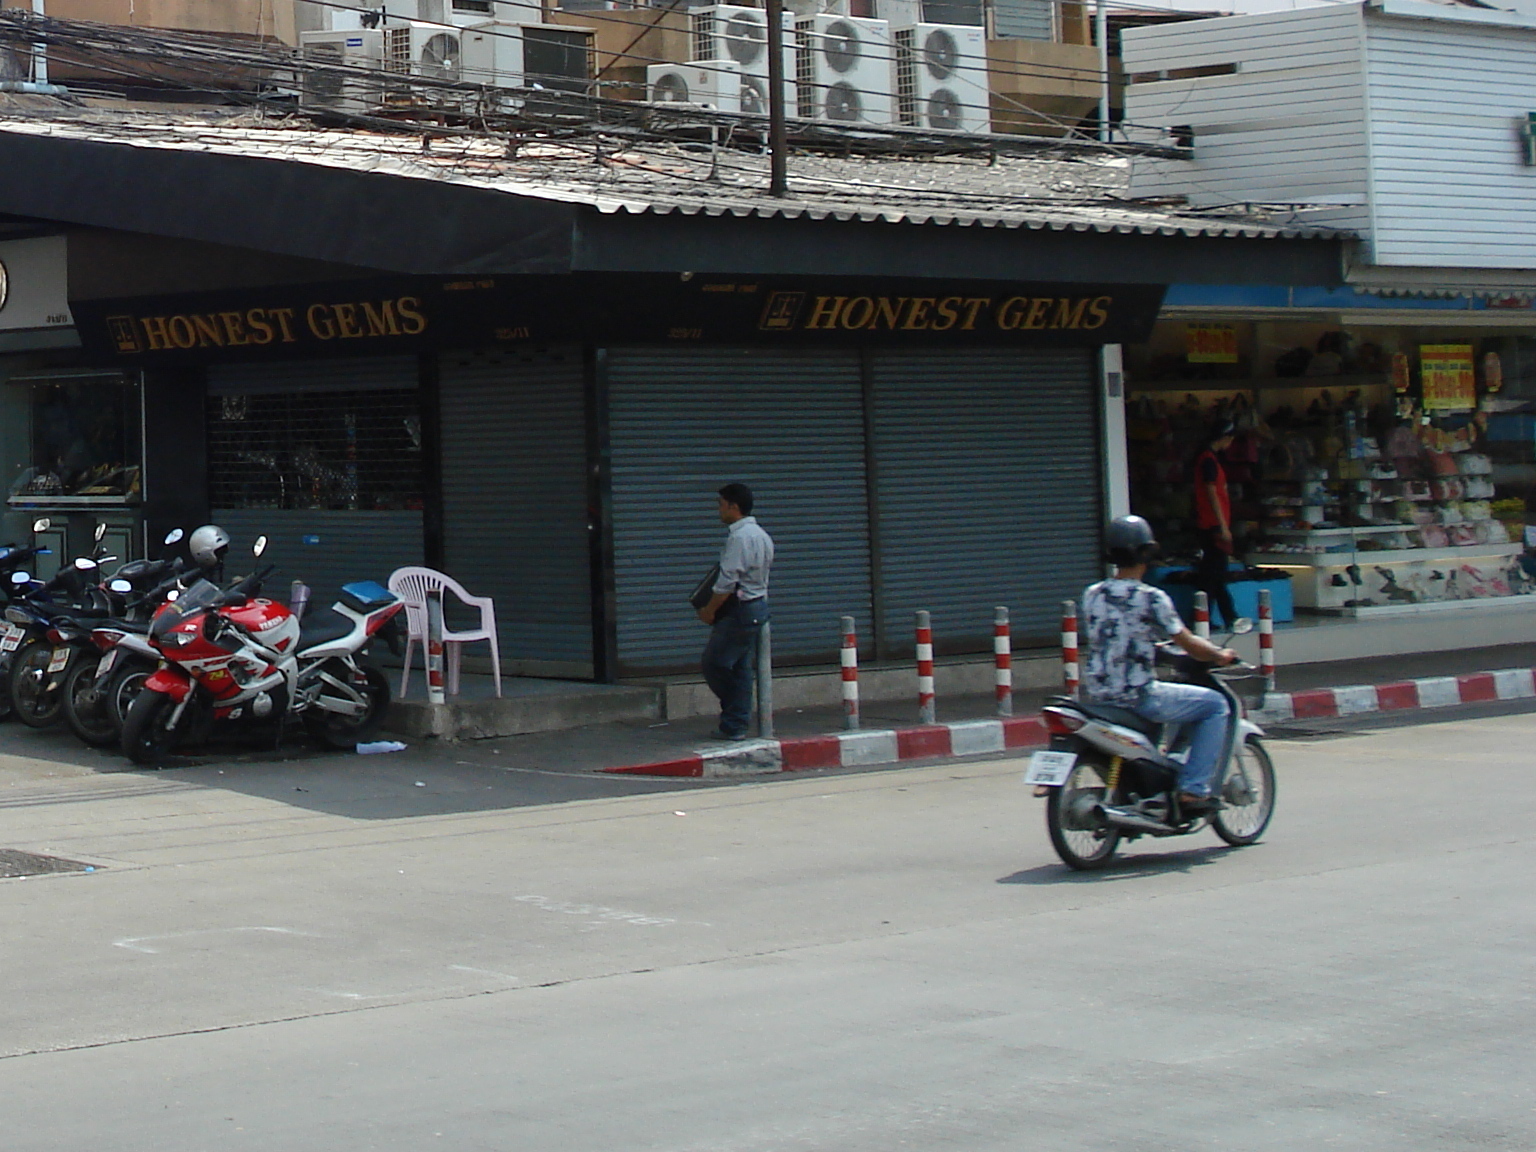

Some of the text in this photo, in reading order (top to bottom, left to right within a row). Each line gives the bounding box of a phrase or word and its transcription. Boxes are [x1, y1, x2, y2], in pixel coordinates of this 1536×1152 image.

[140, 296, 427, 350] HONEST GEMS
[805, 296, 1112, 330] HONEST GEMS
